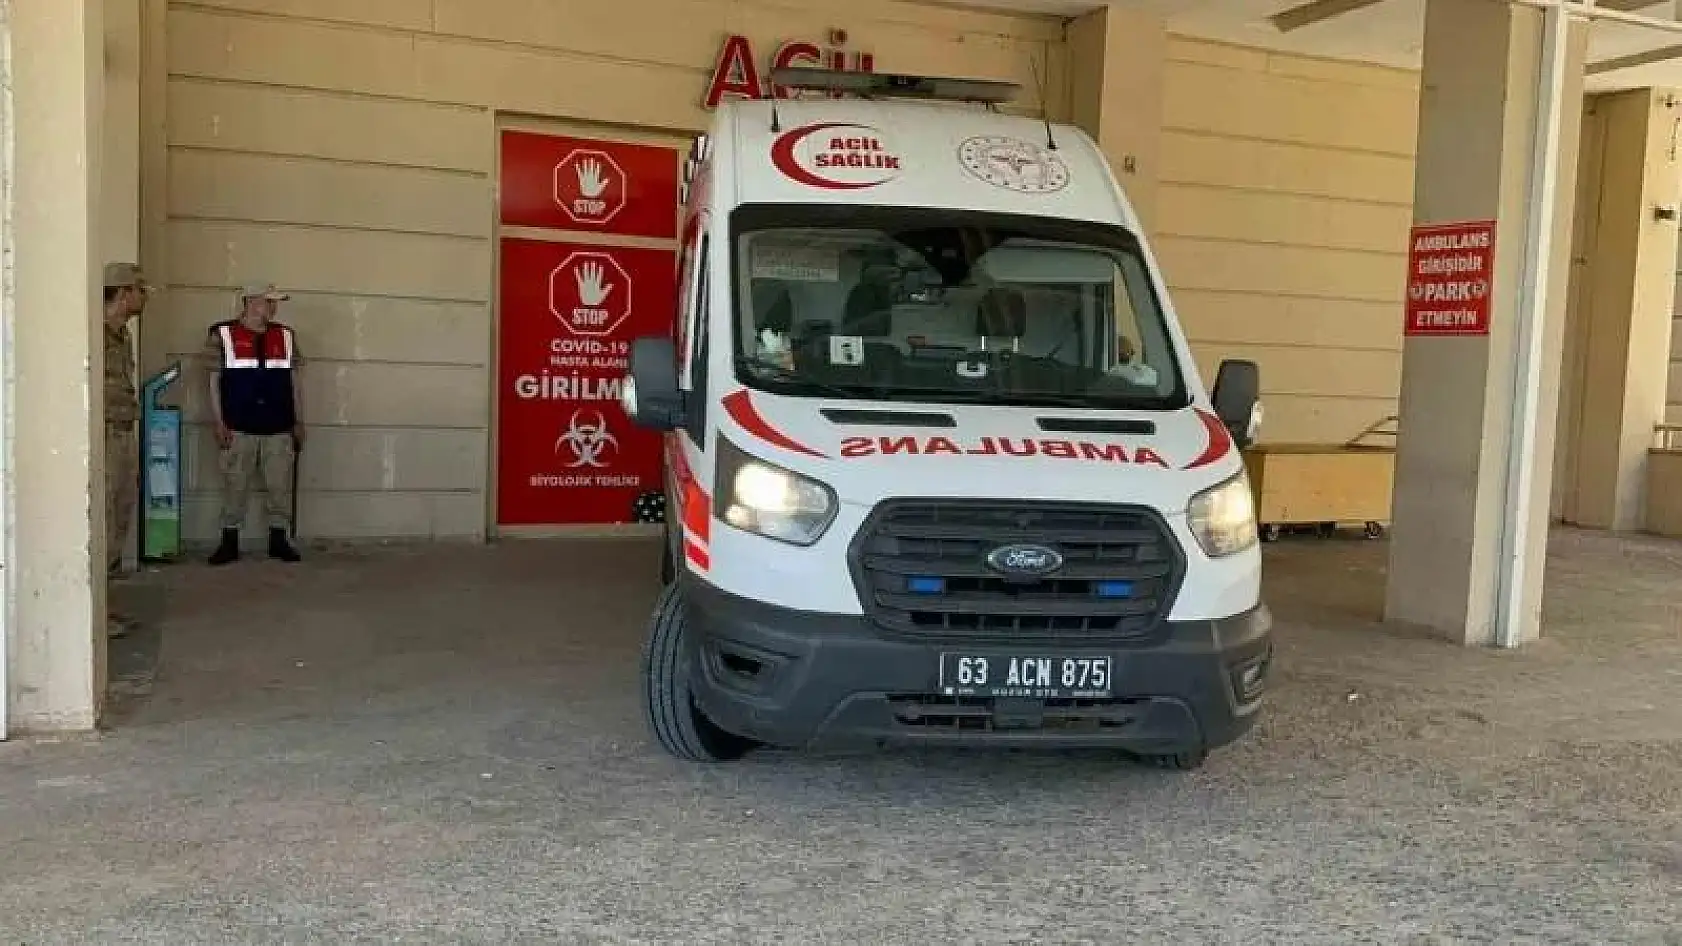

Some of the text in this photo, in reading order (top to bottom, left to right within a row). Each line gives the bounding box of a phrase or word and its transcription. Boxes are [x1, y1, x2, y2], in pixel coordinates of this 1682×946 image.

[574, 199, 606, 215] STOP
[1425, 281, 1471, 302] PARK
[572, 308, 608, 325] STOP
[515, 367, 634, 400] GİRİLM
[1005, 548, 1046, 566] Ford
[958, 657, 1106, 688] 63 ACN 875
